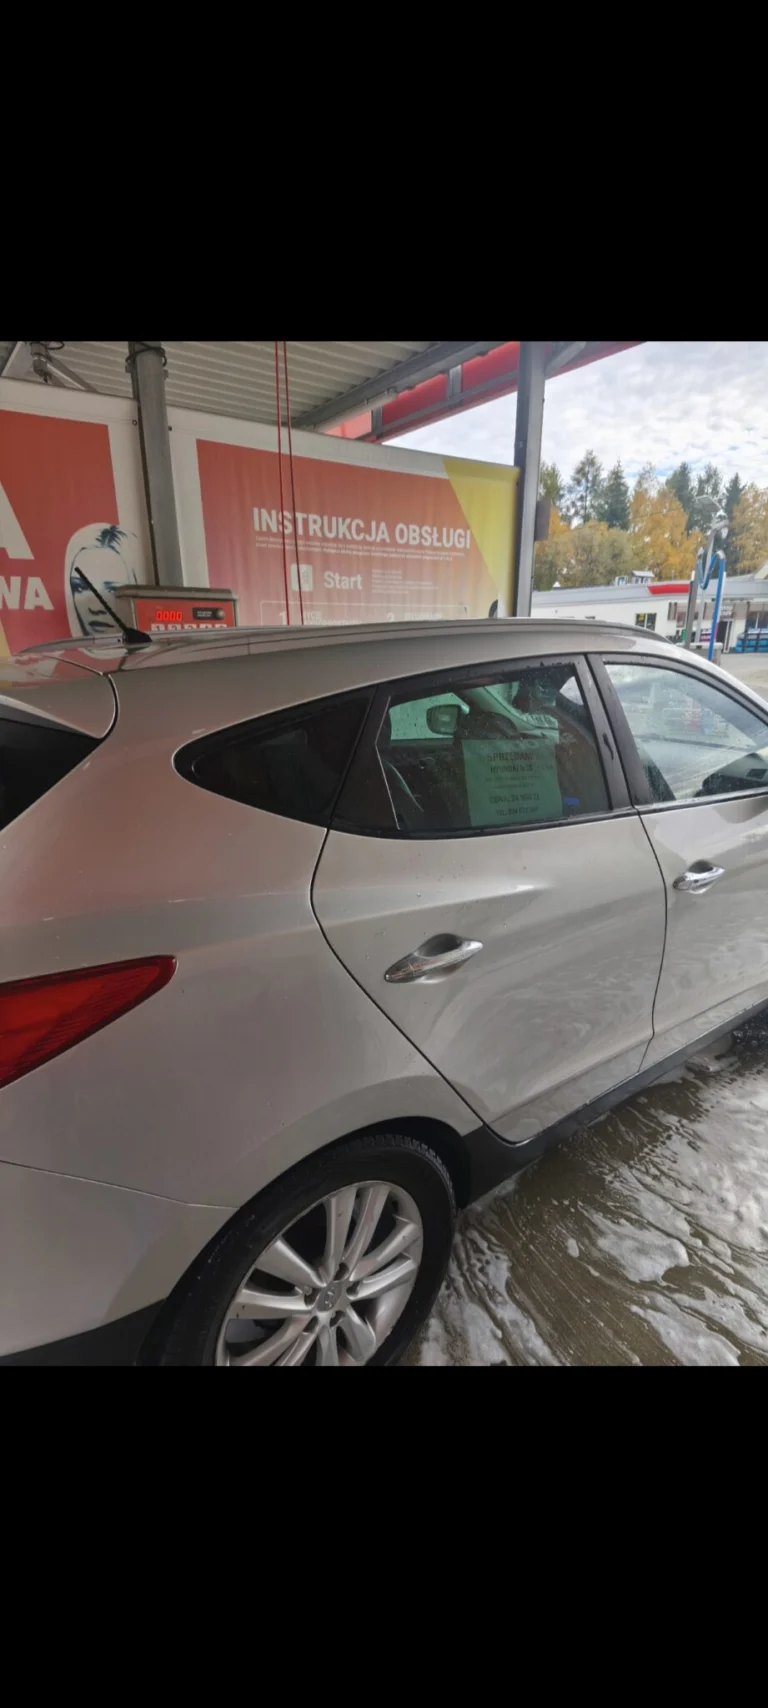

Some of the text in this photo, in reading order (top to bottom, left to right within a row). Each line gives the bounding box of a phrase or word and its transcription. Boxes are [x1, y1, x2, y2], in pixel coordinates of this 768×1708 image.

[253, 507, 390, 543] INSTRUKCJA
[395, 523, 471, 549] OBSŁUGI
[323, 571, 363, 590] Start
[156, 610, 183, 621] 0000
